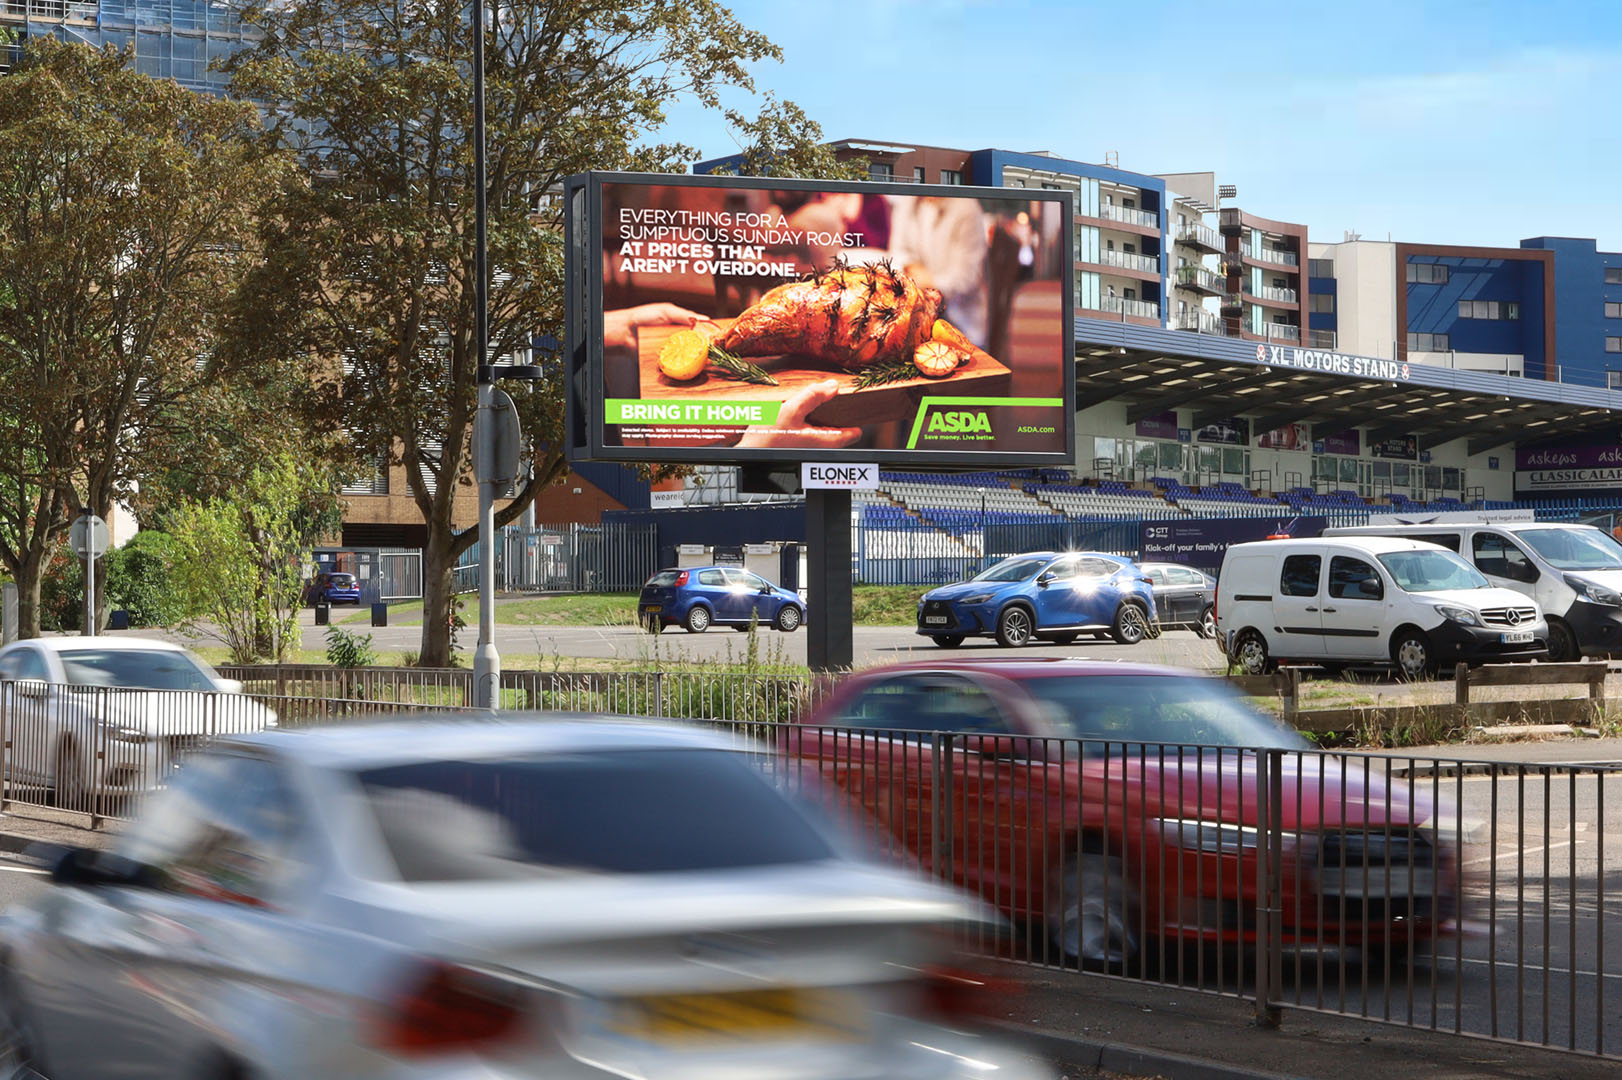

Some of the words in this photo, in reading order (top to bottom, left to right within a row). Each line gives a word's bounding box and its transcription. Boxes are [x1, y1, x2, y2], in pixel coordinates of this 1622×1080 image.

[619, 208, 732, 227] EVERYTHING
[736, 212, 771, 228] FOR
[775, 214, 788, 228] A
[619, 225, 729, 242] SUMPTUOUS
[733, 229, 803, 245] SUNDAY
[807, 231, 865, 247] ROAST.
[619, 241, 644, 257] AT
[648, 242, 714, 259] PRICES
[717, 245, 765, 260] THAT
[619, 258, 689, 274] AREN'T
[693, 260, 801, 278] OVERDONE.
[1270, 346, 1289, 366] XL
[1293, 349, 1350, 373] MOTORS
[1353, 357, 1399, 379] STAND
[621, 404, 681, 420] BRING
[685, 405, 703, 420] IT
[707, 405, 762, 421] HOME
[927, 411, 992, 433] ASDA
[1017, 425, 1055, 433] ASDA.com
[1527, 450, 1577, 465] askews
[810, 467, 869, 481] ELONEX
[1530, 470, 1588, 481] CLASSIC
[1145, 543, 1176, 552] Kick-off
[1177, 544, 1193, 553] your
[1195, 542, 1224, 552] family's
